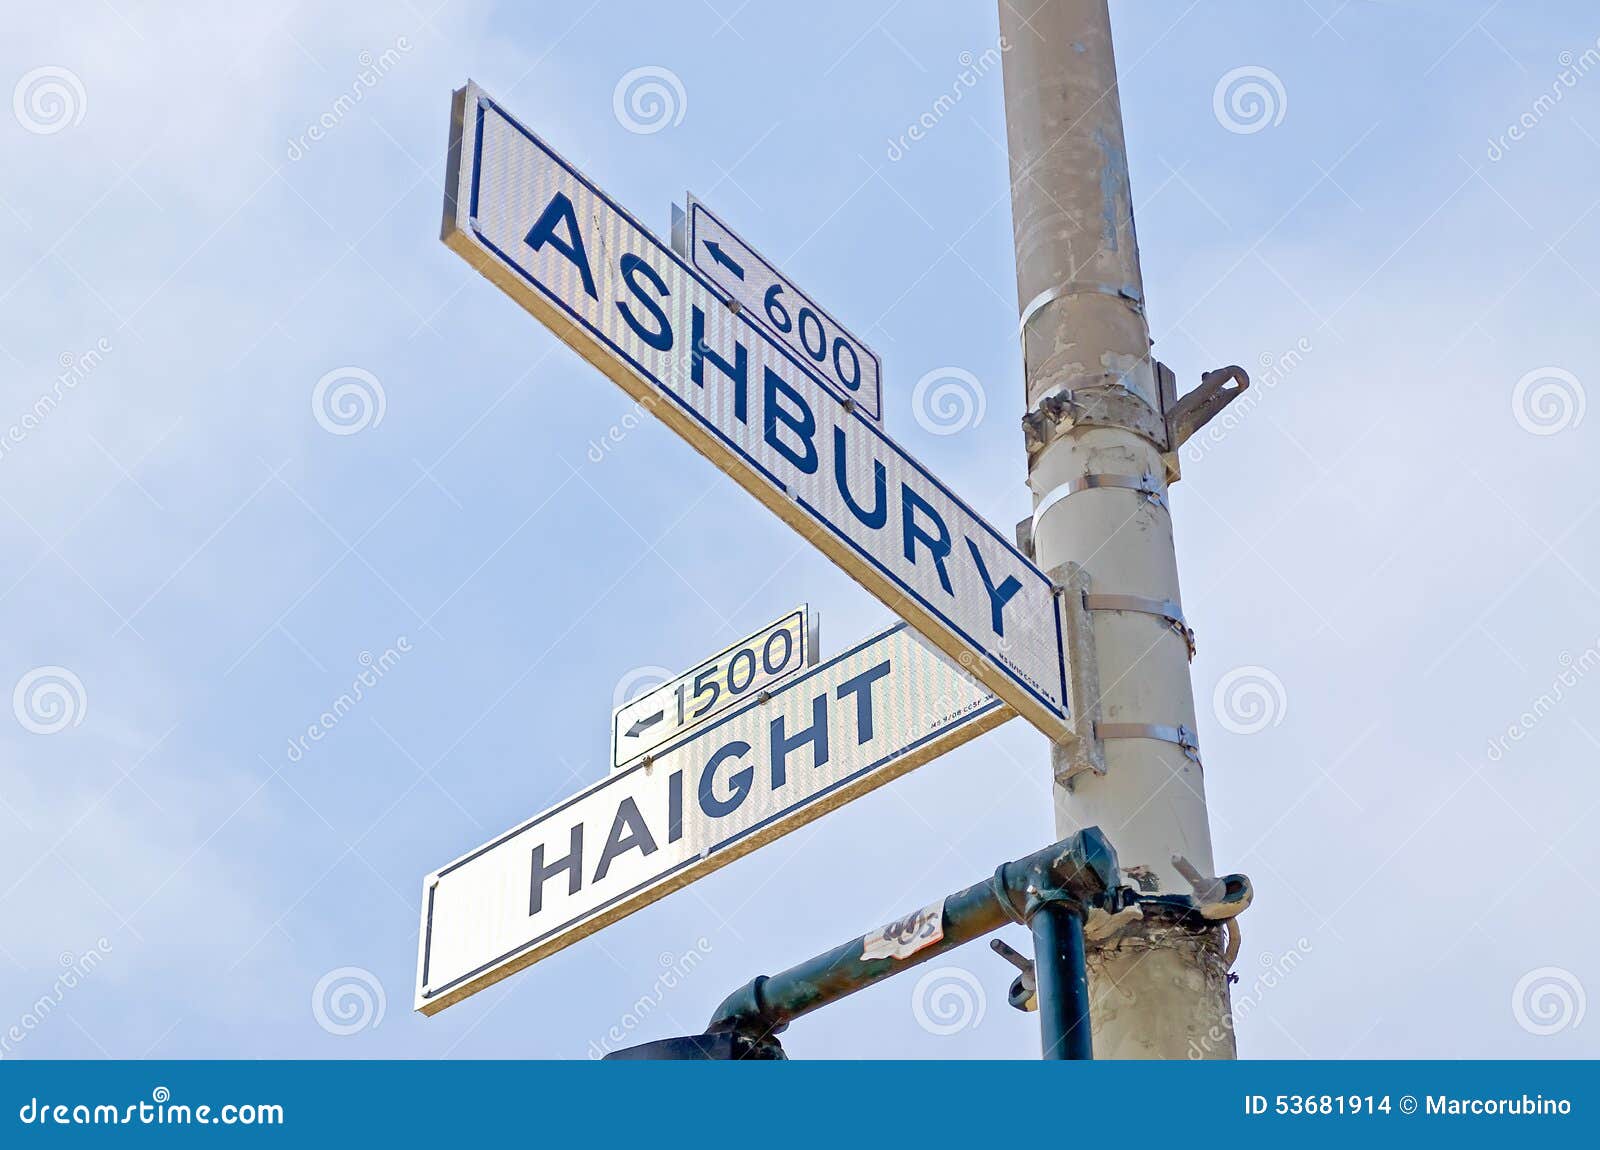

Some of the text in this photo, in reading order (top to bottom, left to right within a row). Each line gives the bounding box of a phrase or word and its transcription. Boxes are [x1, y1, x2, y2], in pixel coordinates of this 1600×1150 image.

[524, 192, 1023, 637] ASHBURY
[764, 284, 862, 392] 600
[673, 628, 793, 727] 1500
[529, 659, 890, 916] HAIGHT
